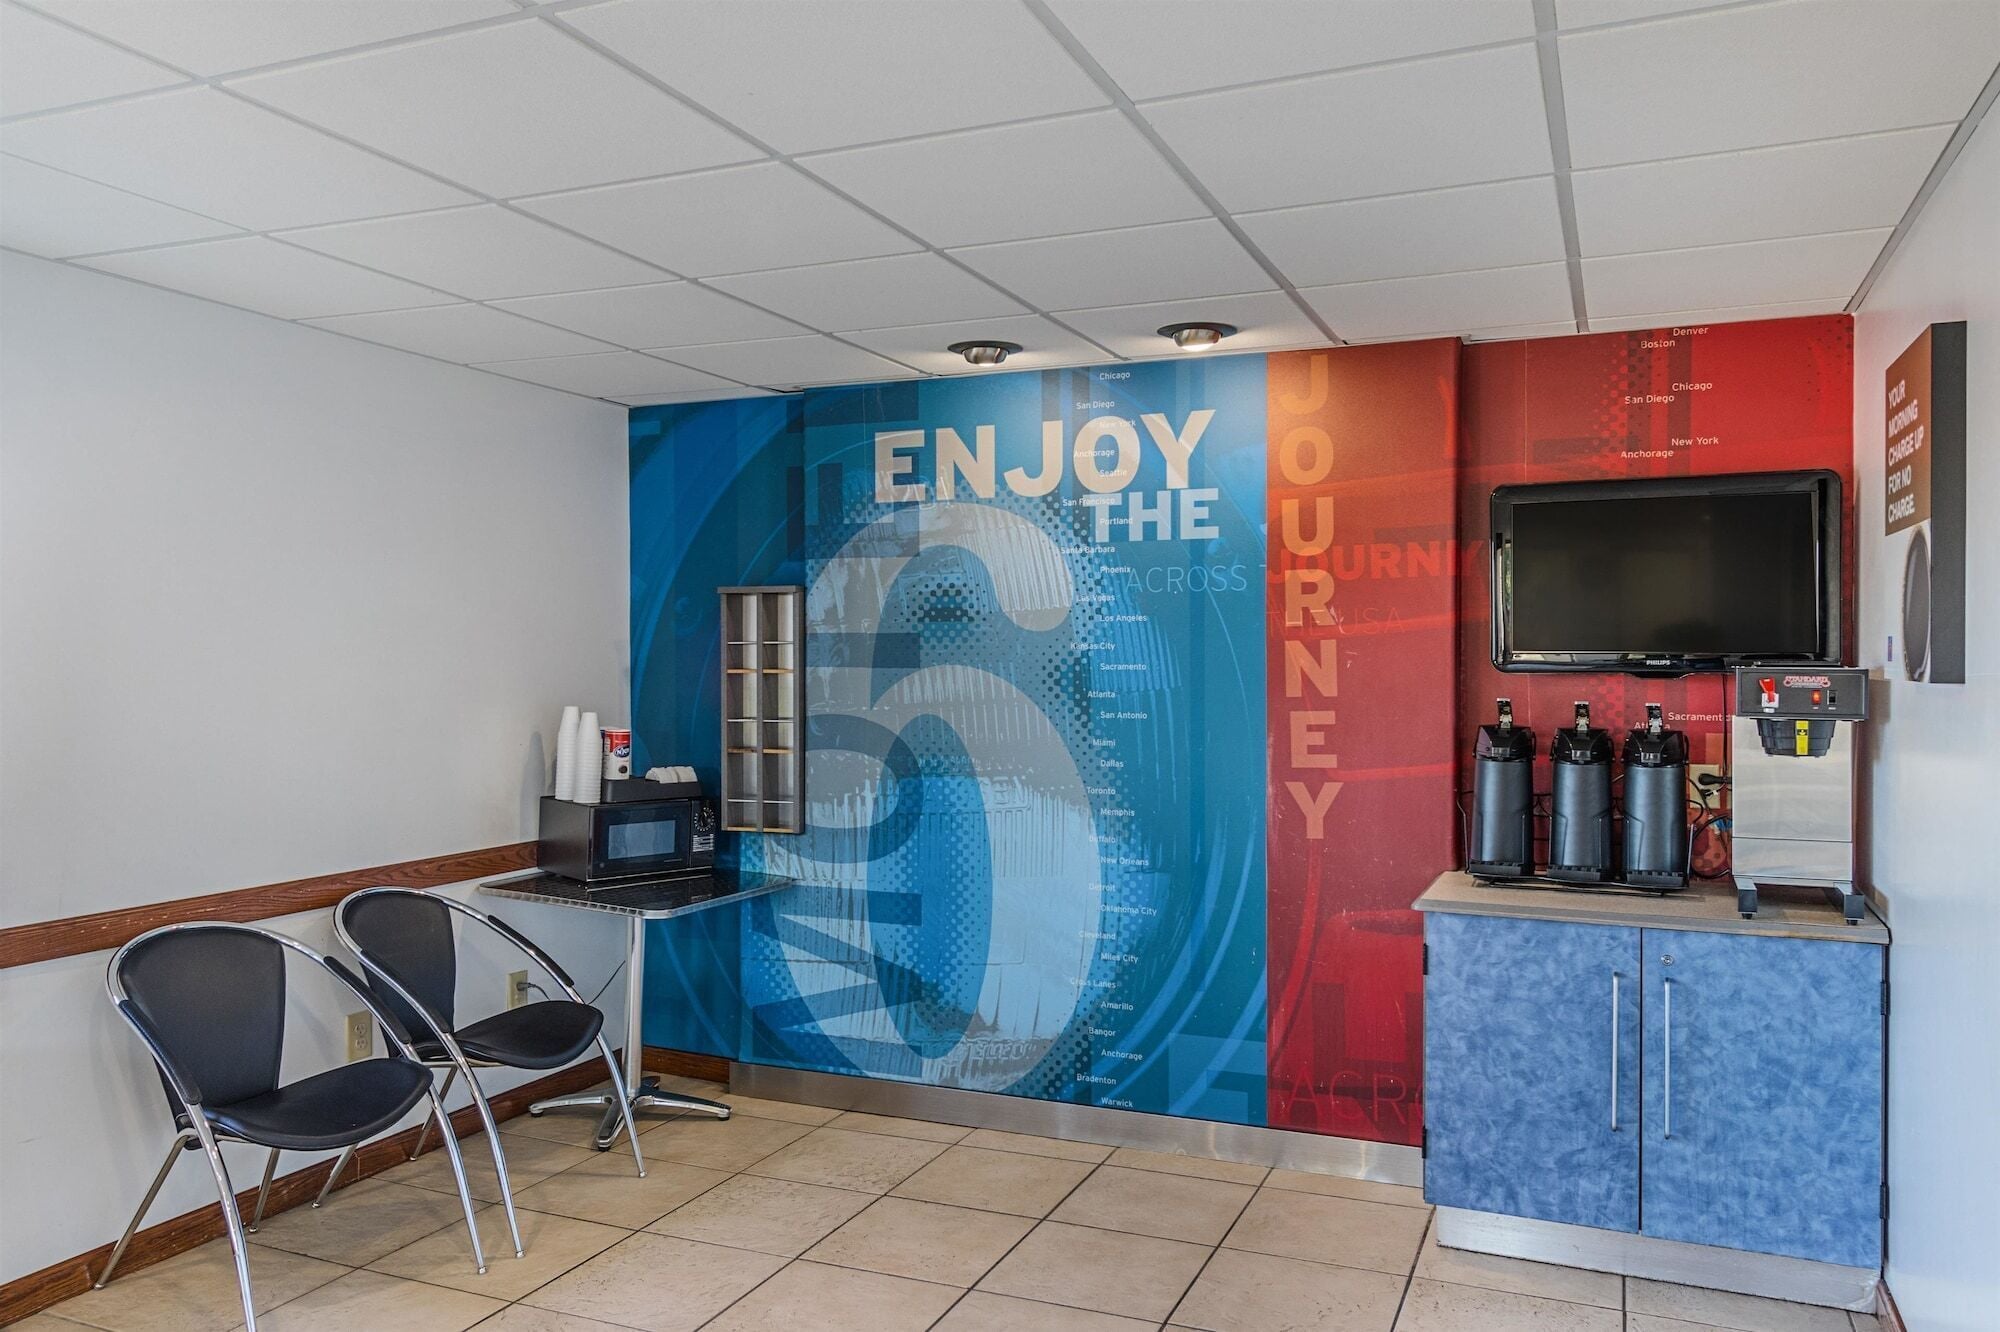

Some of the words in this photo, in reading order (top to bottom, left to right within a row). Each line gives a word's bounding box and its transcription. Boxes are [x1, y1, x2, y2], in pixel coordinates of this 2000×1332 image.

[1672, 327, 1709, 337] Denver
[1640, 339, 1676, 349] Boston
[1099, 371, 1131, 381] Chicago
[1671, 382, 1713, 391] Chicago
[1624, 396, 1643, 405] San
[1646, 394, 1675, 404] Diego
[1888, 380, 1906, 409] YOUR
[1076, 402, 1091, 410] San
[1092, 400, 1115, 409] Diego
[1888, 399, 1918, 438] MORNING
[1671, 438, 1693, 446] New
[1696, 436, 1719, 446] York
[1888, 433, 1914, 467] CHARGE
[1914, 425, 1924, 450] UP
[875, 409, 1217, 503] ENJOY
[1073, 448, 1115, 458] Anchorage
[1621, 449, 1674, 459] Anchorage
[1888, 472, 1901, 495] FOR
[1901, 464, 1912, 489] NO
[1063, 499, 1077, 507] San
[1079, 497, 1116, 506] Francisco
[1083, 487, 1220, 543] THE
[1099, 517, 1134, 526] Portland
[1060, 546, 1082, 554] Santa
[1084, 545, 1116, 553] Barbara
[1100, 566, 1131, 574] Phoenix
[1126, 565, 1248, 593] ACROSS
[1076, 594, 1091, 602] Las
[1280, 354, 1344, 840] JOURNEY
[1115, 614, 1148, 623] Angeles
[1070, 642, 1098, 650] Kansas
[1099, 642, 1116, 651] City
[1100, 663, 1147, 671] Sacramento
[1087, 691, 1116, 699] Atlanta
[1116, 711, 1148, 720] Antonio
[1633, 721, 1671, 730] Atla
[1092, 738, 1116, 747] Miami
[1100, 760, 1124, 768] Dallas
[1087, 787, 1116, 795] Toronto
[1101, 808, 1135, 818] Memphis
[1101, 857, 1117, 865] New
[1119, 857, 1149, 866] Orleans
[1100, 905, 1139, 914] Oklahoma
[1141, 907, 1157, 917] City
[1101, 953, 1121, 961] Miles
[1122, 954, 1139, 963] City
[1093, 980, 1117, 989] Lanes
[1101, 1001, 1134, 1011] Amarillo
[1088, 1027, 1116, 1037] Bangor
[1101, 1049, 1143, 1061] Anchorage
[1076, 1073, 1117, 1085] Bradenton
[1101, 1097, 1133, 1108] Warwick
